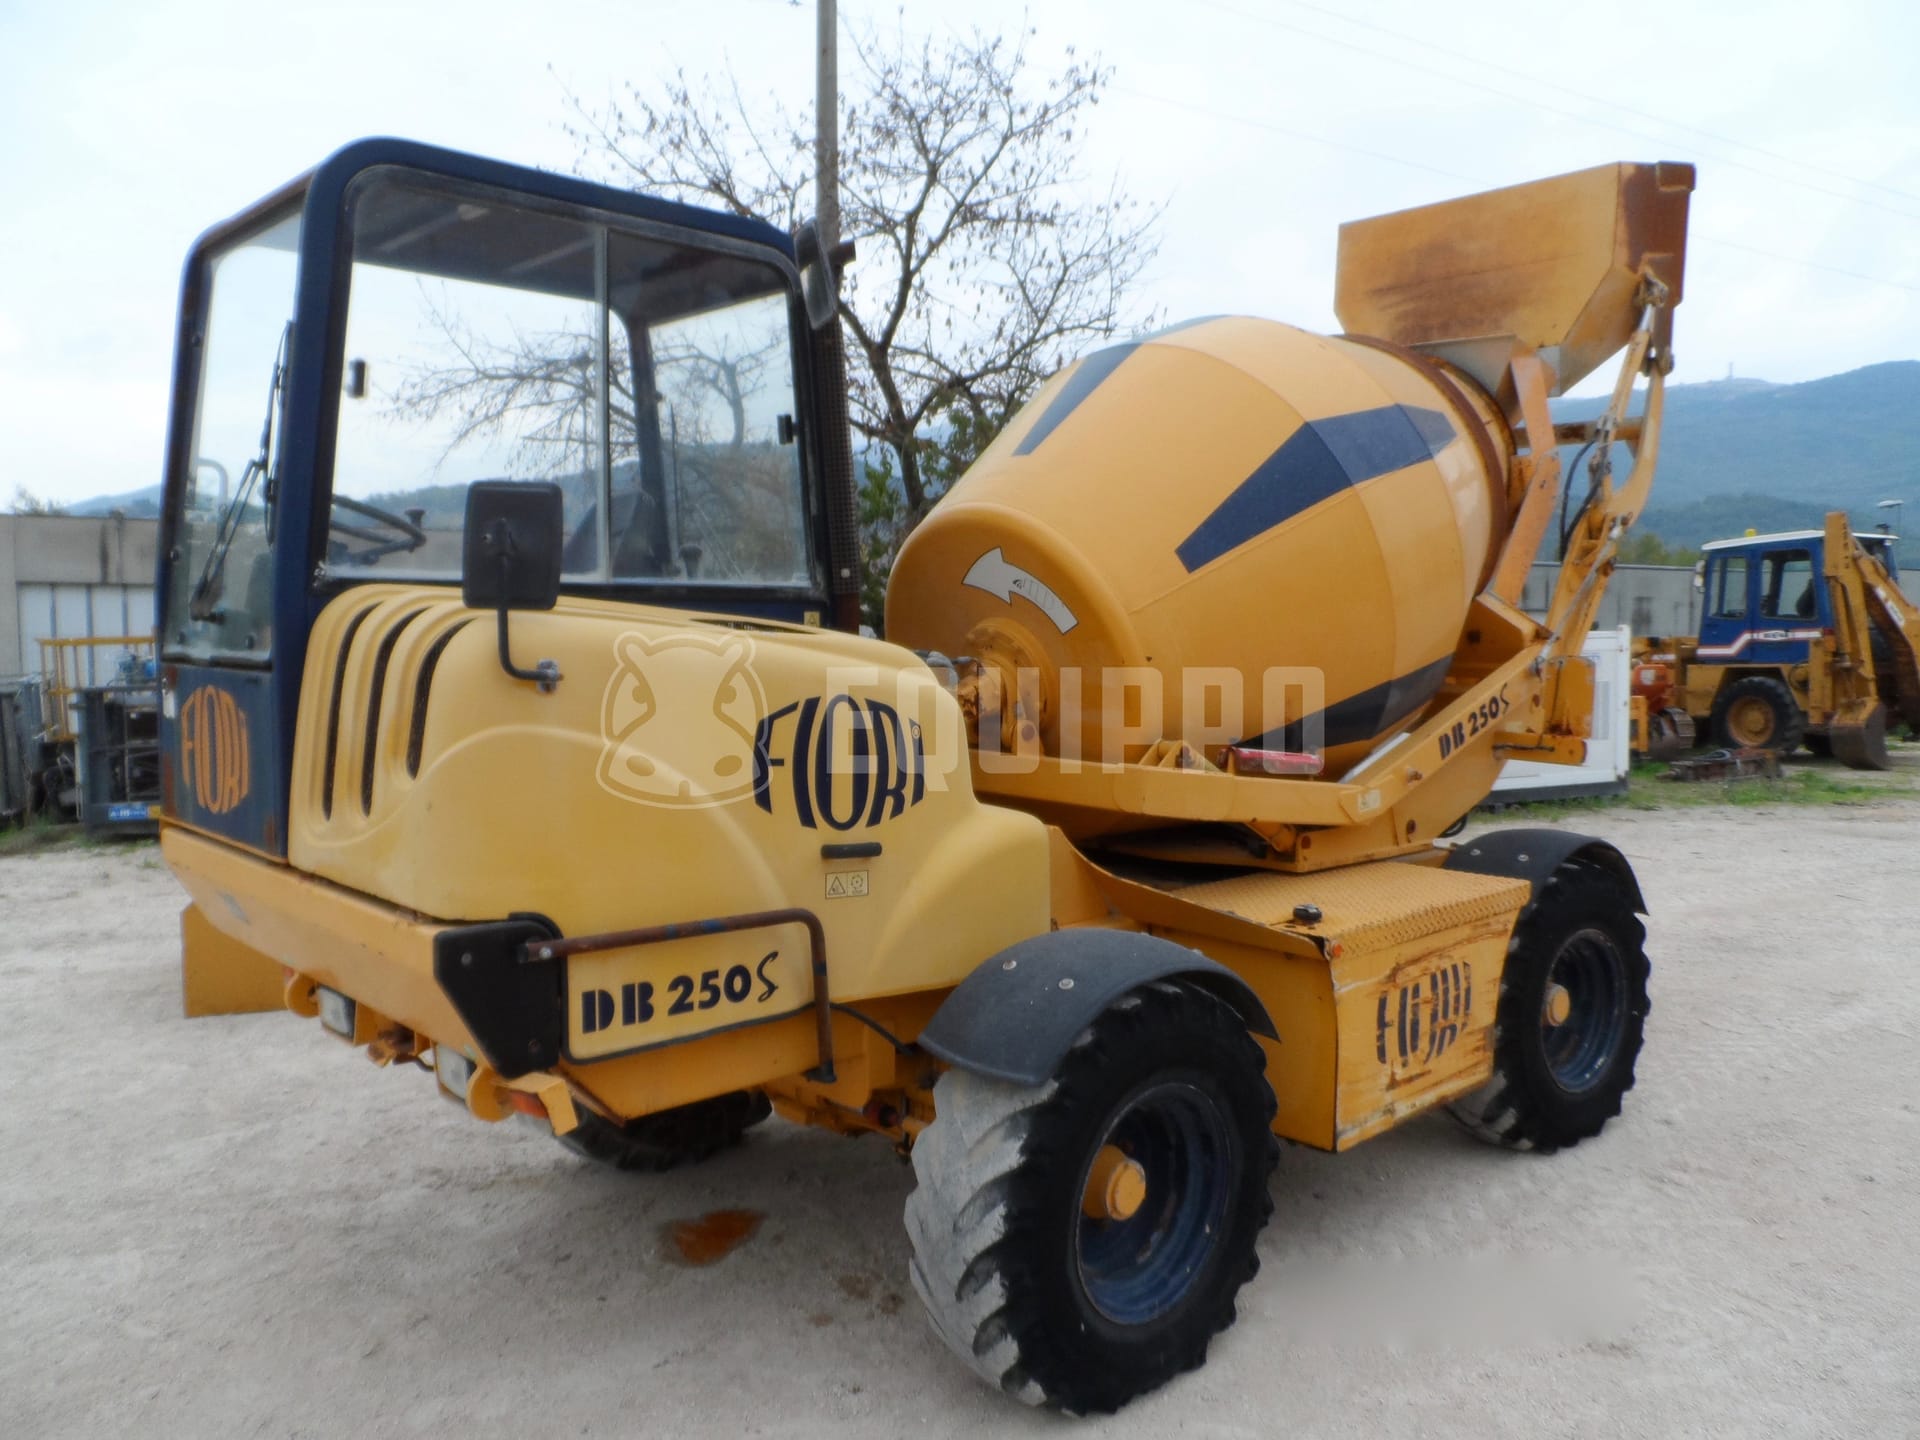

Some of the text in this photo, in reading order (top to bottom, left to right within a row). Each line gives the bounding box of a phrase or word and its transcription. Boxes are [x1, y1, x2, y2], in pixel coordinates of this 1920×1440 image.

[753, 694, 925, 831] FIORI
[1438, 721, 1466, 760] DB
[581, 982, 654, 1034] DB
